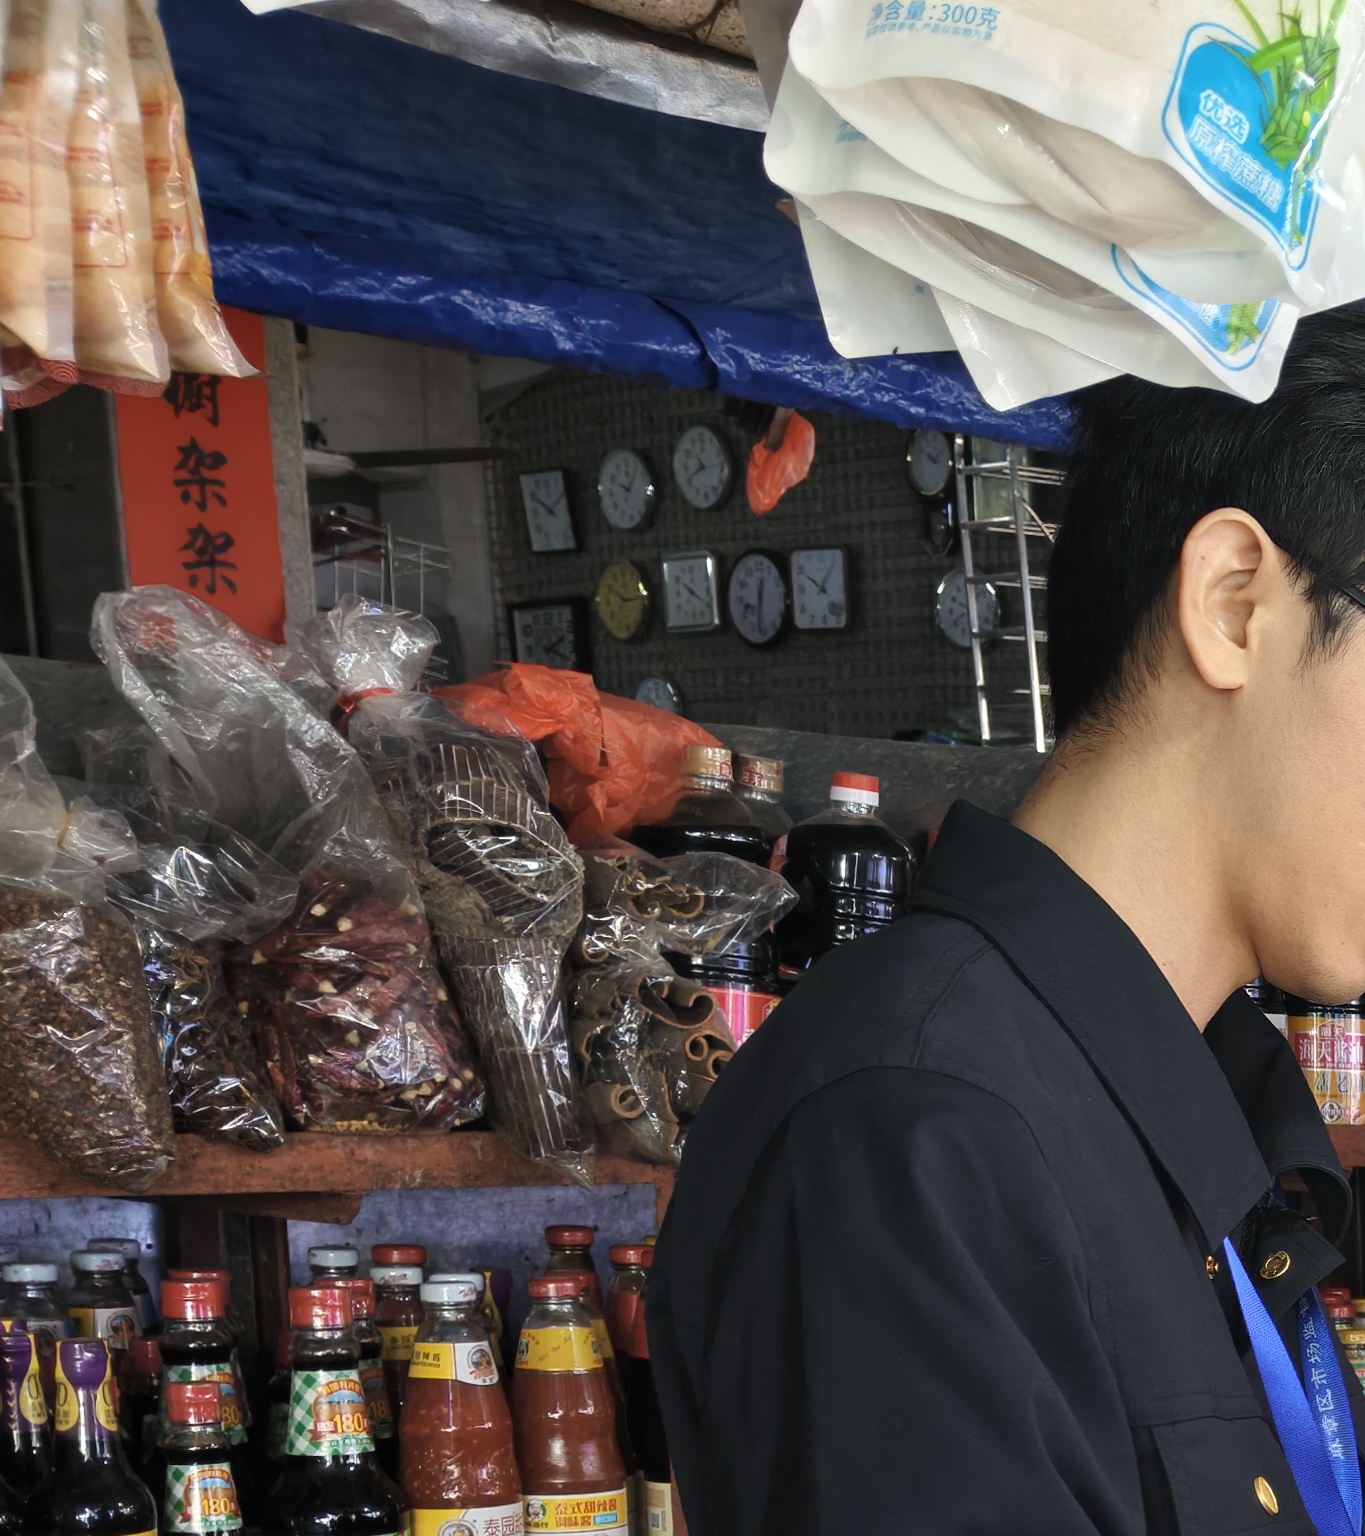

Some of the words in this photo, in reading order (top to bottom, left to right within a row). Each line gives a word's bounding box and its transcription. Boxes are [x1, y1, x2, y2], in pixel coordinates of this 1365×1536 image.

[1199, 88, 1250, 145] 优选
[333, 1413, 364, 1434] 180
[554, 1498, 618, 1517] 泰式甜辣酱
